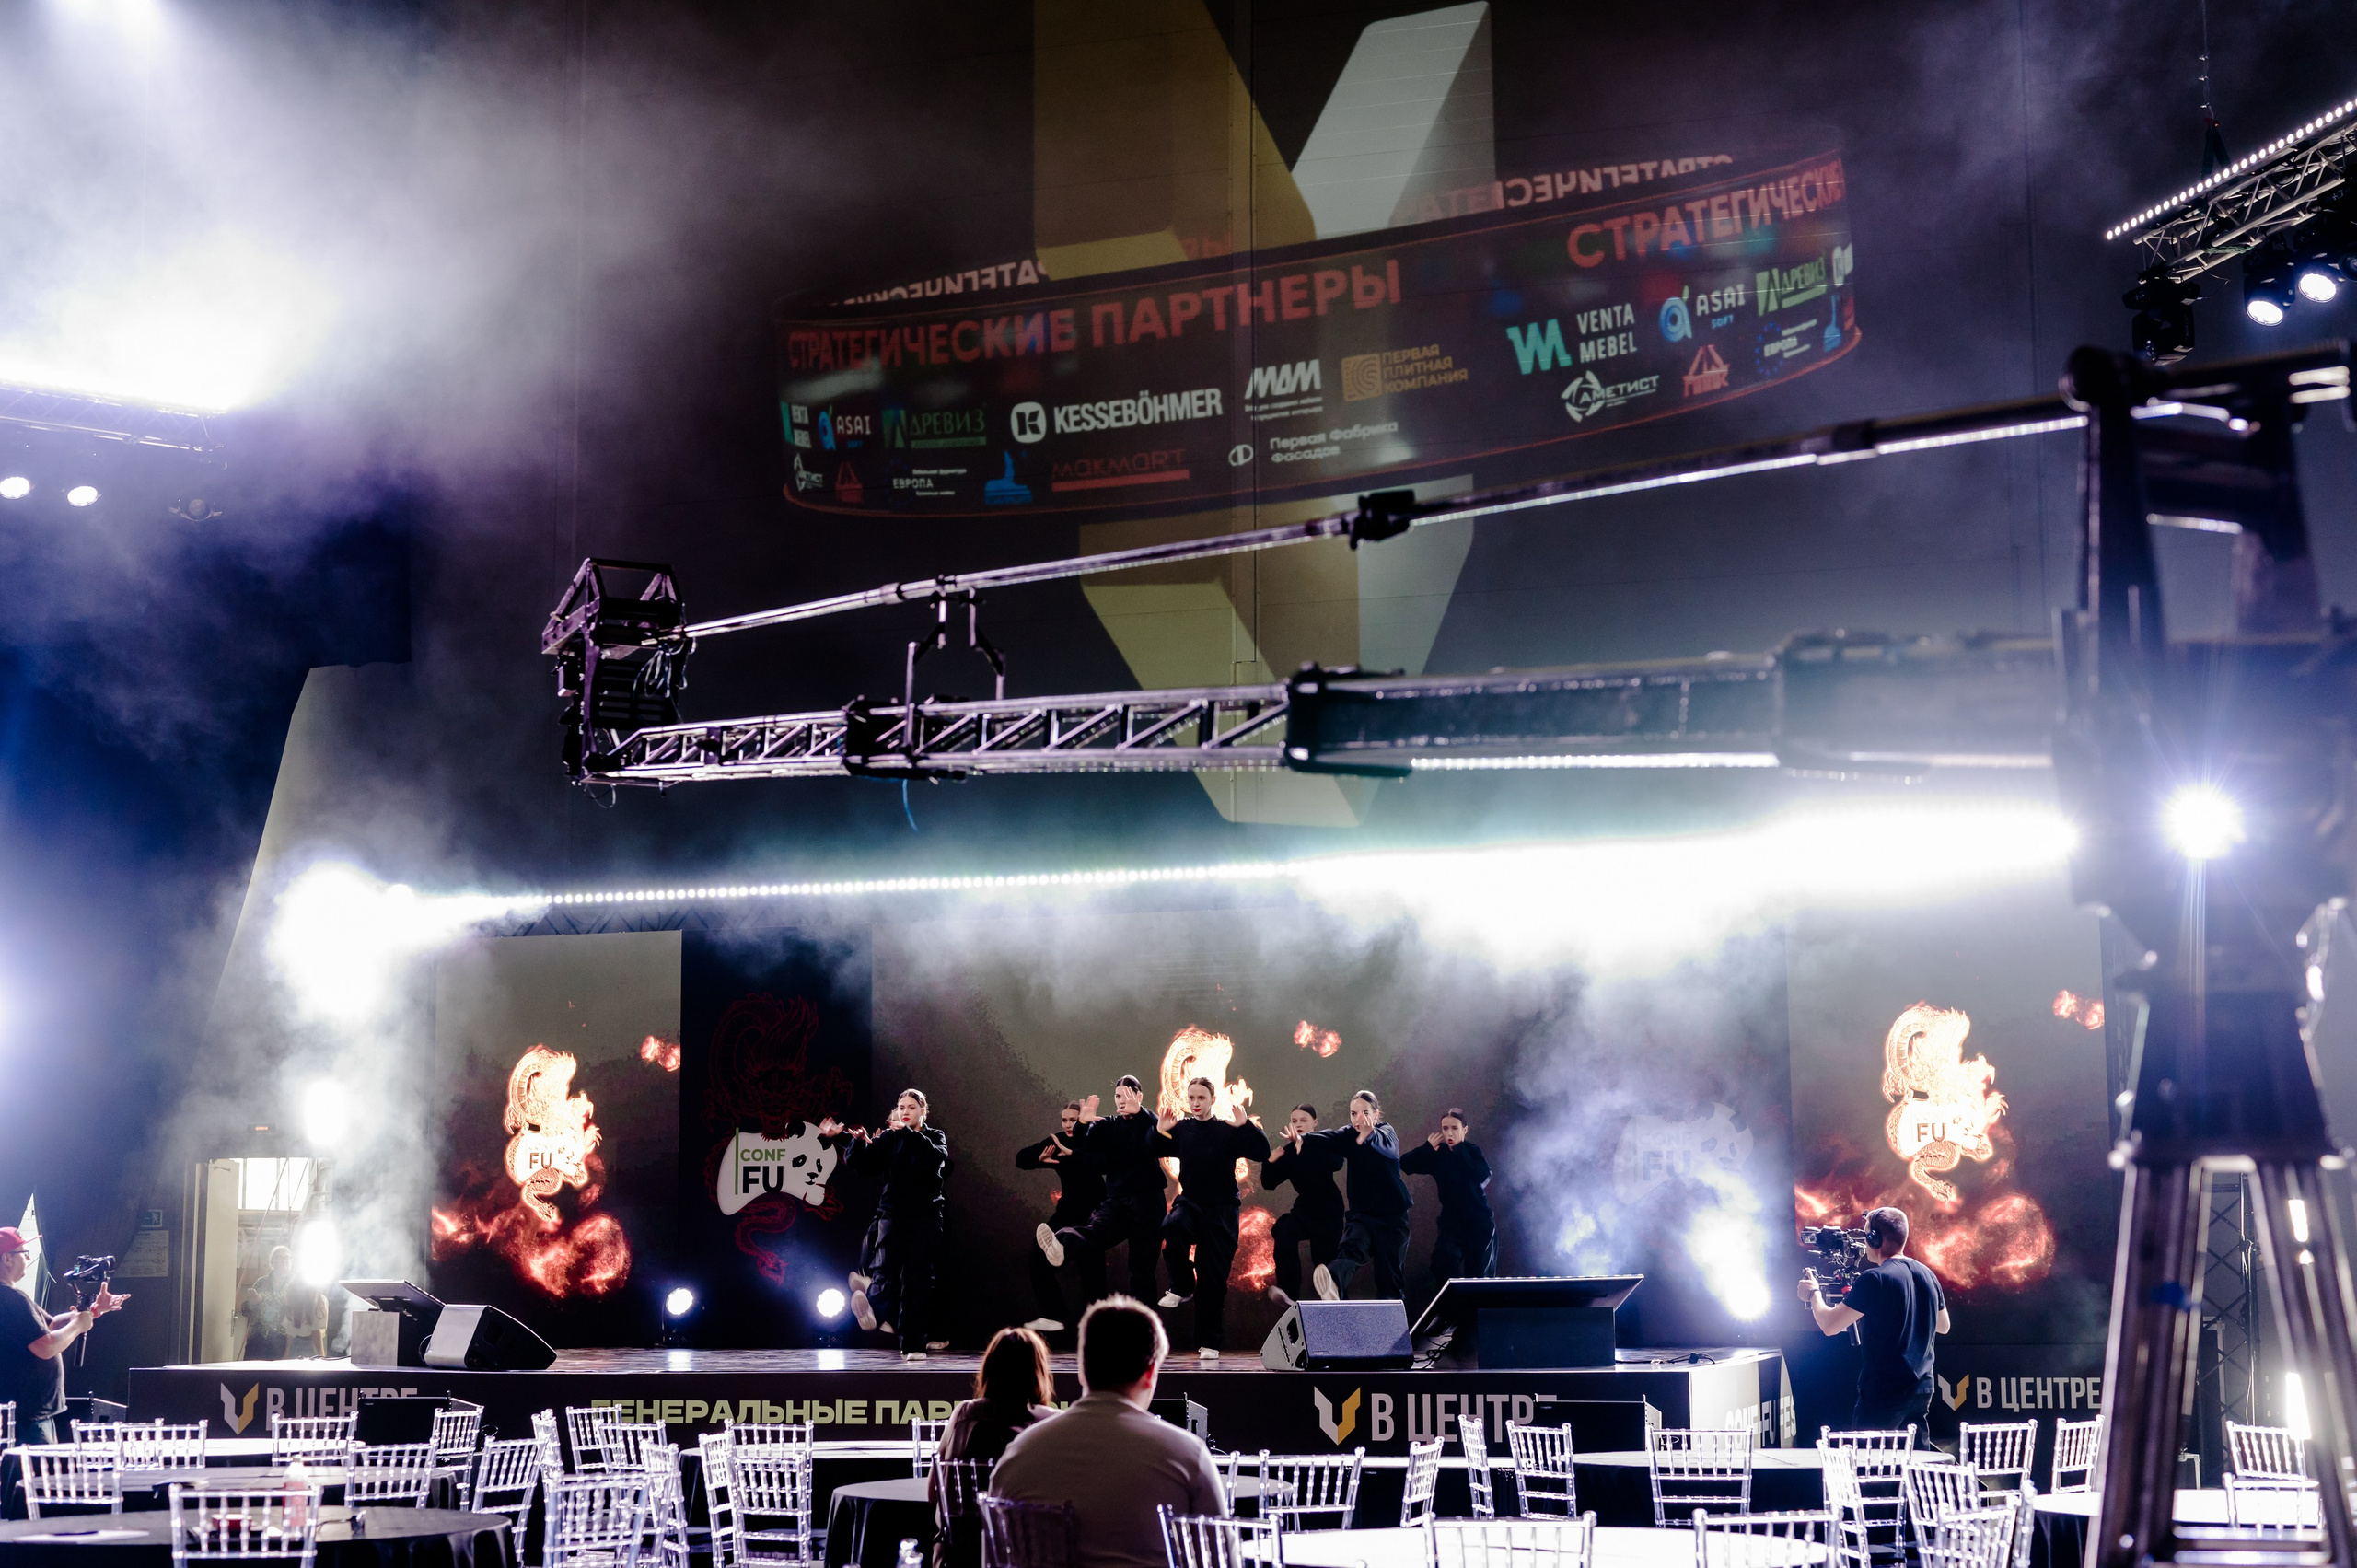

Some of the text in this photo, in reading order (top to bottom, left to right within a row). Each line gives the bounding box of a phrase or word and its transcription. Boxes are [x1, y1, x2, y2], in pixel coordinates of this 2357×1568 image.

[788, 259, 1401, 369] СТРАТЕГИЧЕСКИЕ ПАРТНЕРЫ
[1696, 284, 1746, 317] ASAI
[1576, 303, 1635, 335] VENTA
[1381, 344, 1440, 365] ПЕРВАЯ
[1579, 331, 1637, 364] MEBEL
[1383, 356, 1453, 379] ПЛИТНАЯ
[1383, 368, 1469, 393] КОМПАНИЯ
[1579, 375, 1660, 404] АМЕТИСТ
[836, 415, 872, 436] ASAI
[1053, 388, 1224, 434] KESSEBÖHMER
[1270, 421, 1399, 450] Первая Фабрика
[1917, 1122, 1945, 1142] FU
[529, 1153, 552, 1169] FU
[740, 1148, 786, 1161] CONF
[1642, 1150, 1691, 1180] FU
[743, 1166, 784, 1193] FU
[1976, 1377, 2102, 1412] В ЦЕНТРЕ
[590, 1399, 868, 1425] ГЕНЕРАЛЬНЫЕ
[1371, 1393, 1558, 1444] В ЦЕНТР
